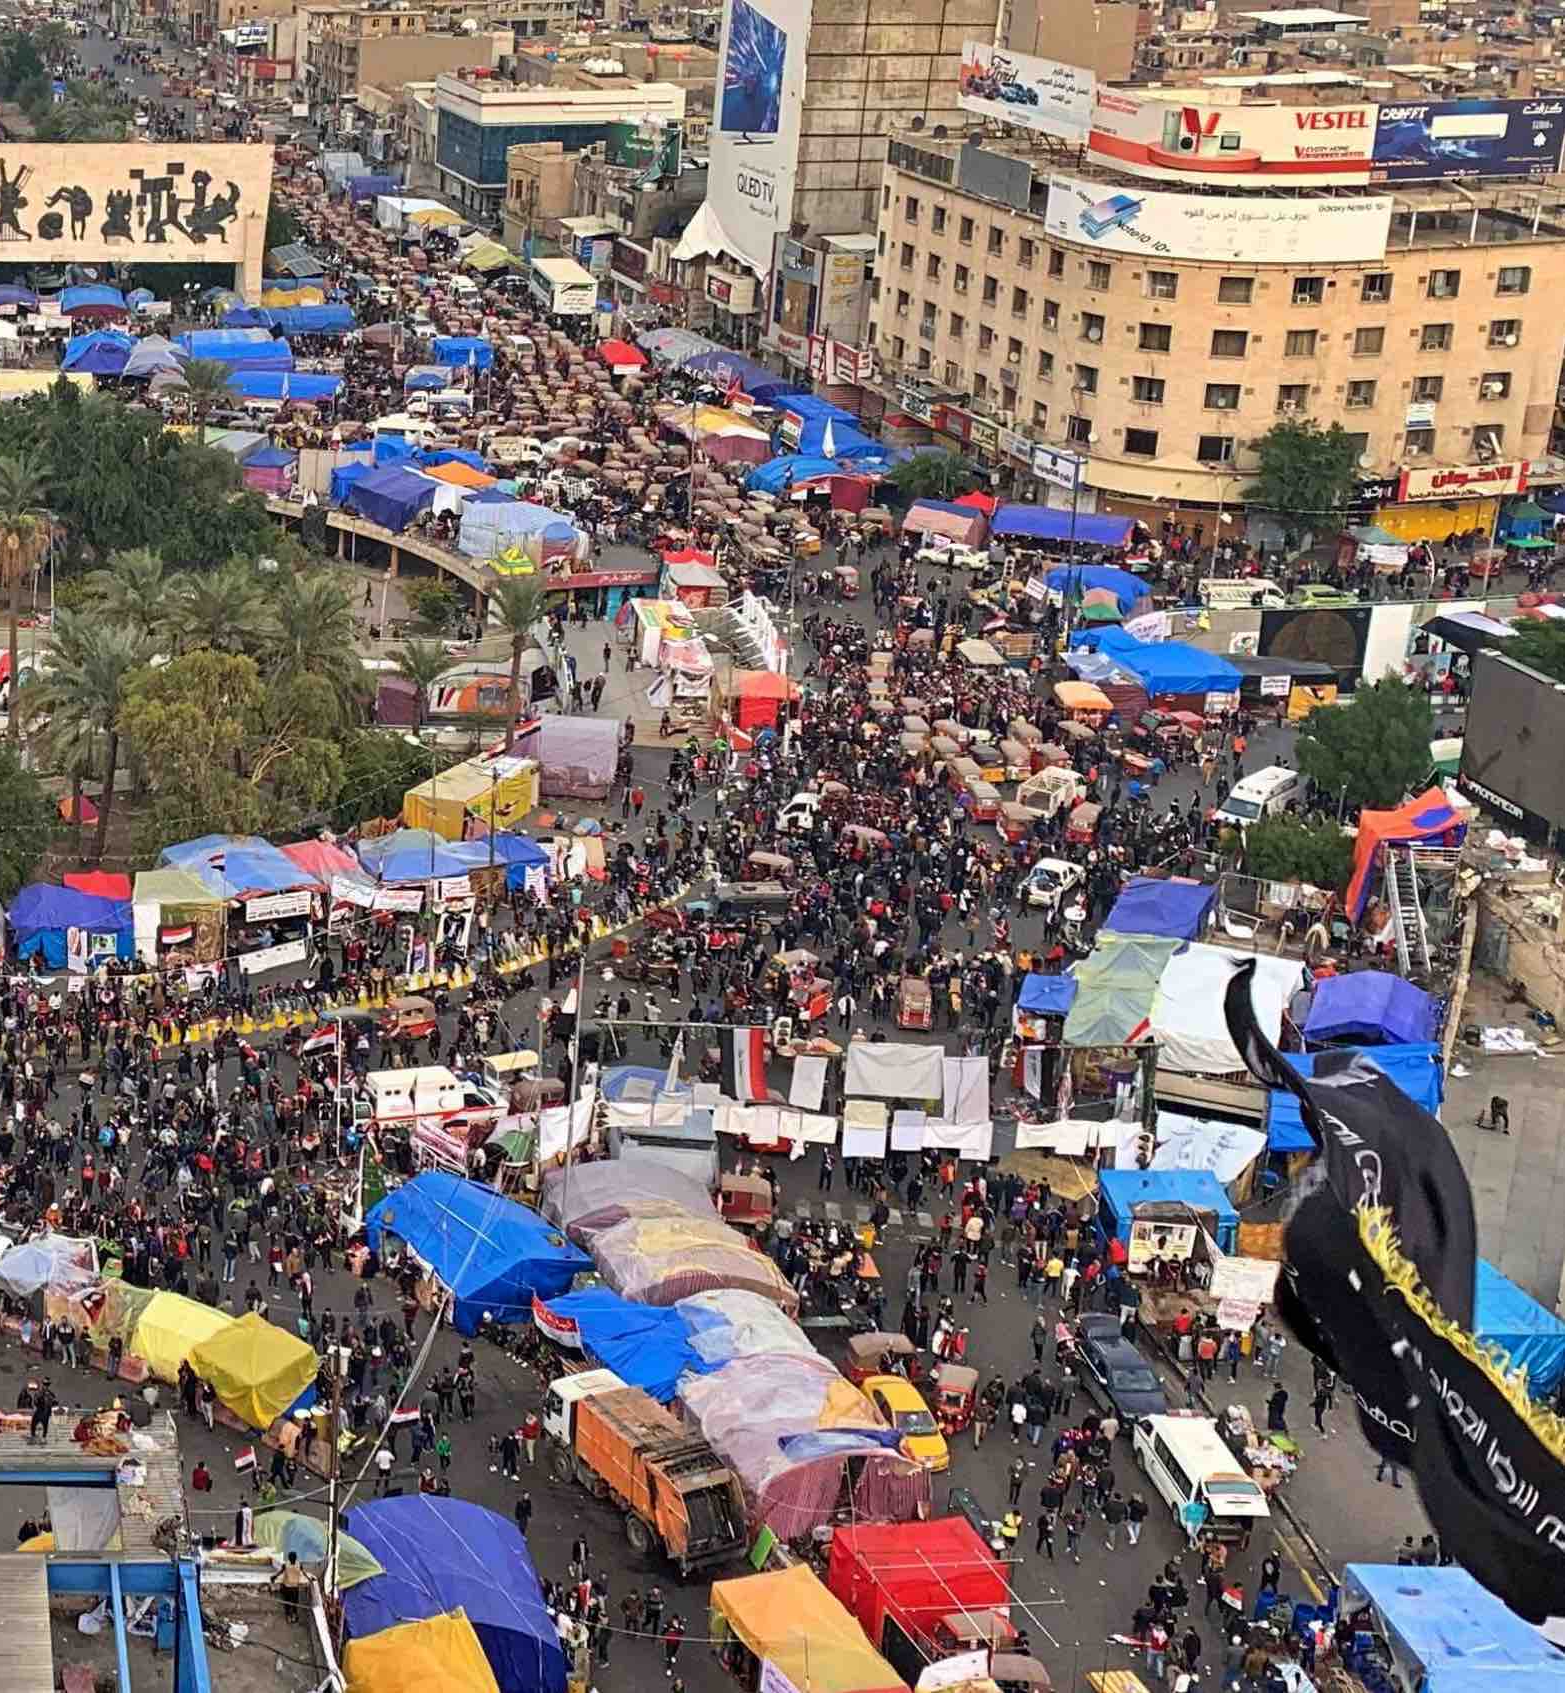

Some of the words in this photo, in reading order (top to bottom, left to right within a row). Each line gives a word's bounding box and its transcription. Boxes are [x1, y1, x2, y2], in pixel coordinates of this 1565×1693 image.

[1295, 111, 1369, 130] VESTEL
[737, 173, 761, 198] QLED
[762, 181, 775, 203] TV
